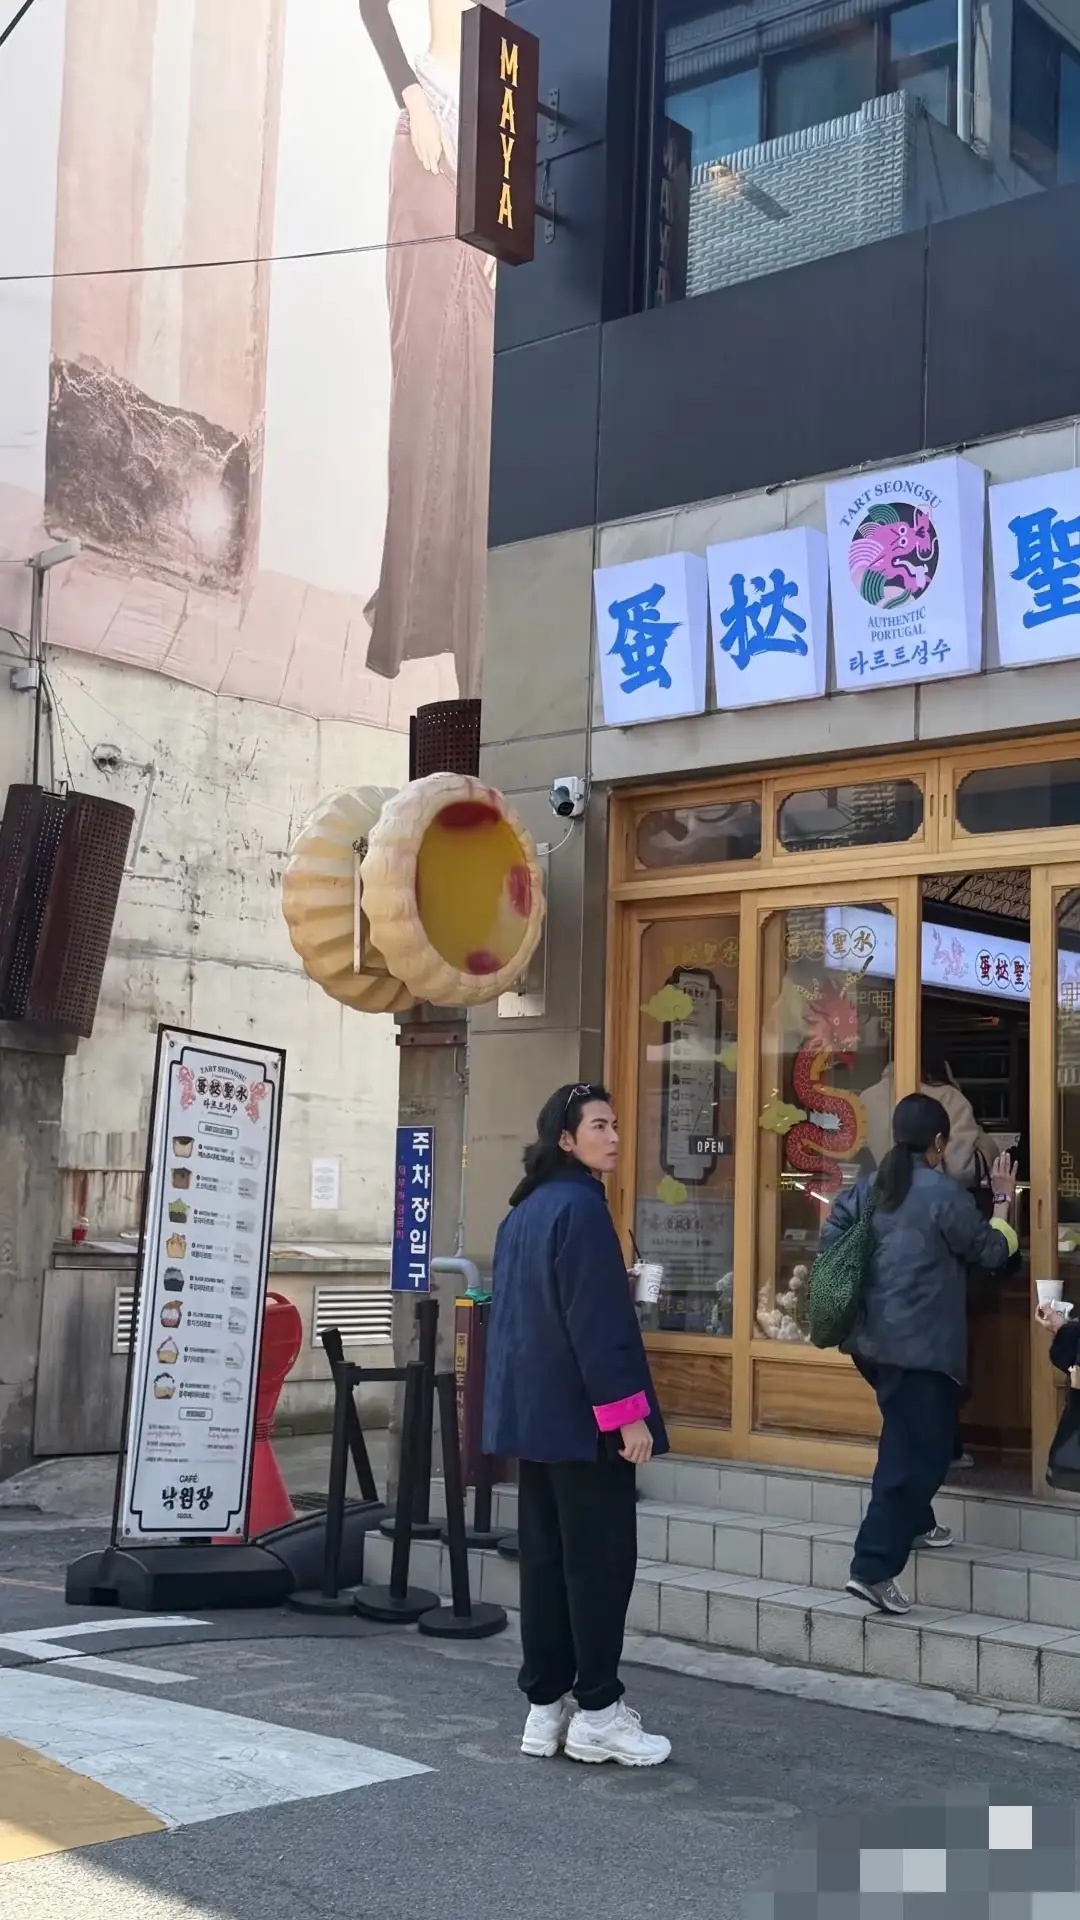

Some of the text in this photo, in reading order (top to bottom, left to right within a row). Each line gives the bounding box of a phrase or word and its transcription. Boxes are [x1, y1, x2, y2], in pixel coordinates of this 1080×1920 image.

[498, 36, 519, 230] MAYA
[839, 479, 942, 528] TART SEONGSU
[867, 605, 927, 630] AUTHENTIC
[870, 622, 926, 643] PORTUGAL
[849, 638, 951, 676] 타르트성수
[200, 1065, 217, 1074] TART
[697, 1141, 724, 1153] OPEN
[408, 1132, 430, 1288] 주차장입구
[179, 1472, 199, 1483] CAFÉ
